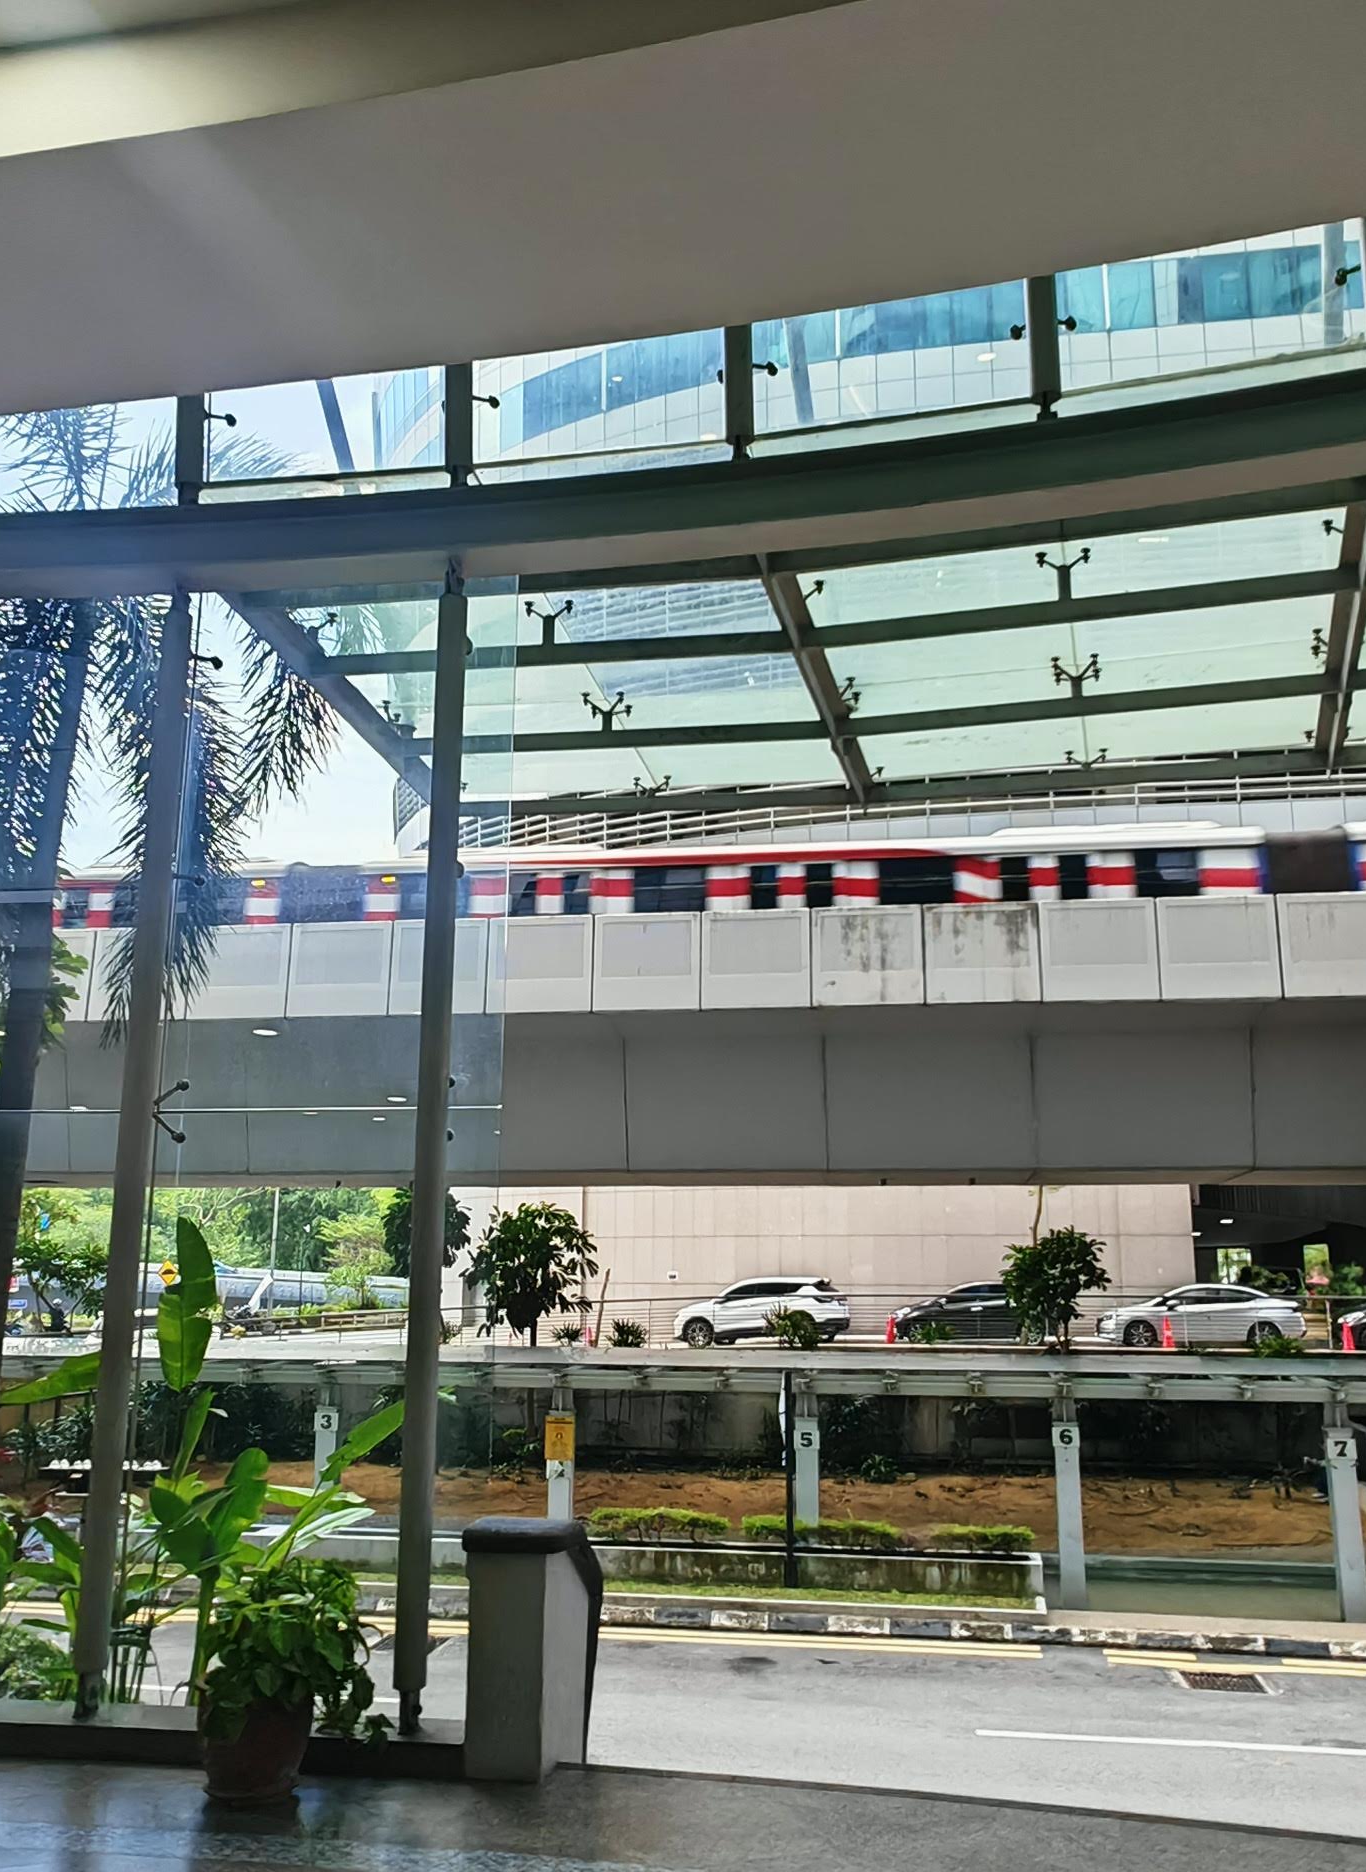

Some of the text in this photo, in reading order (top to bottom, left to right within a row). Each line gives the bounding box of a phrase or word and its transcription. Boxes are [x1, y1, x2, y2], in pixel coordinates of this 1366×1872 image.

[320, 1414, 332, 1430] 3
[800, 1431, 813, 1448] 5
[1059, 1428, 1073, 1446] 6
[1333, 1440, 1348, 1458] 7
